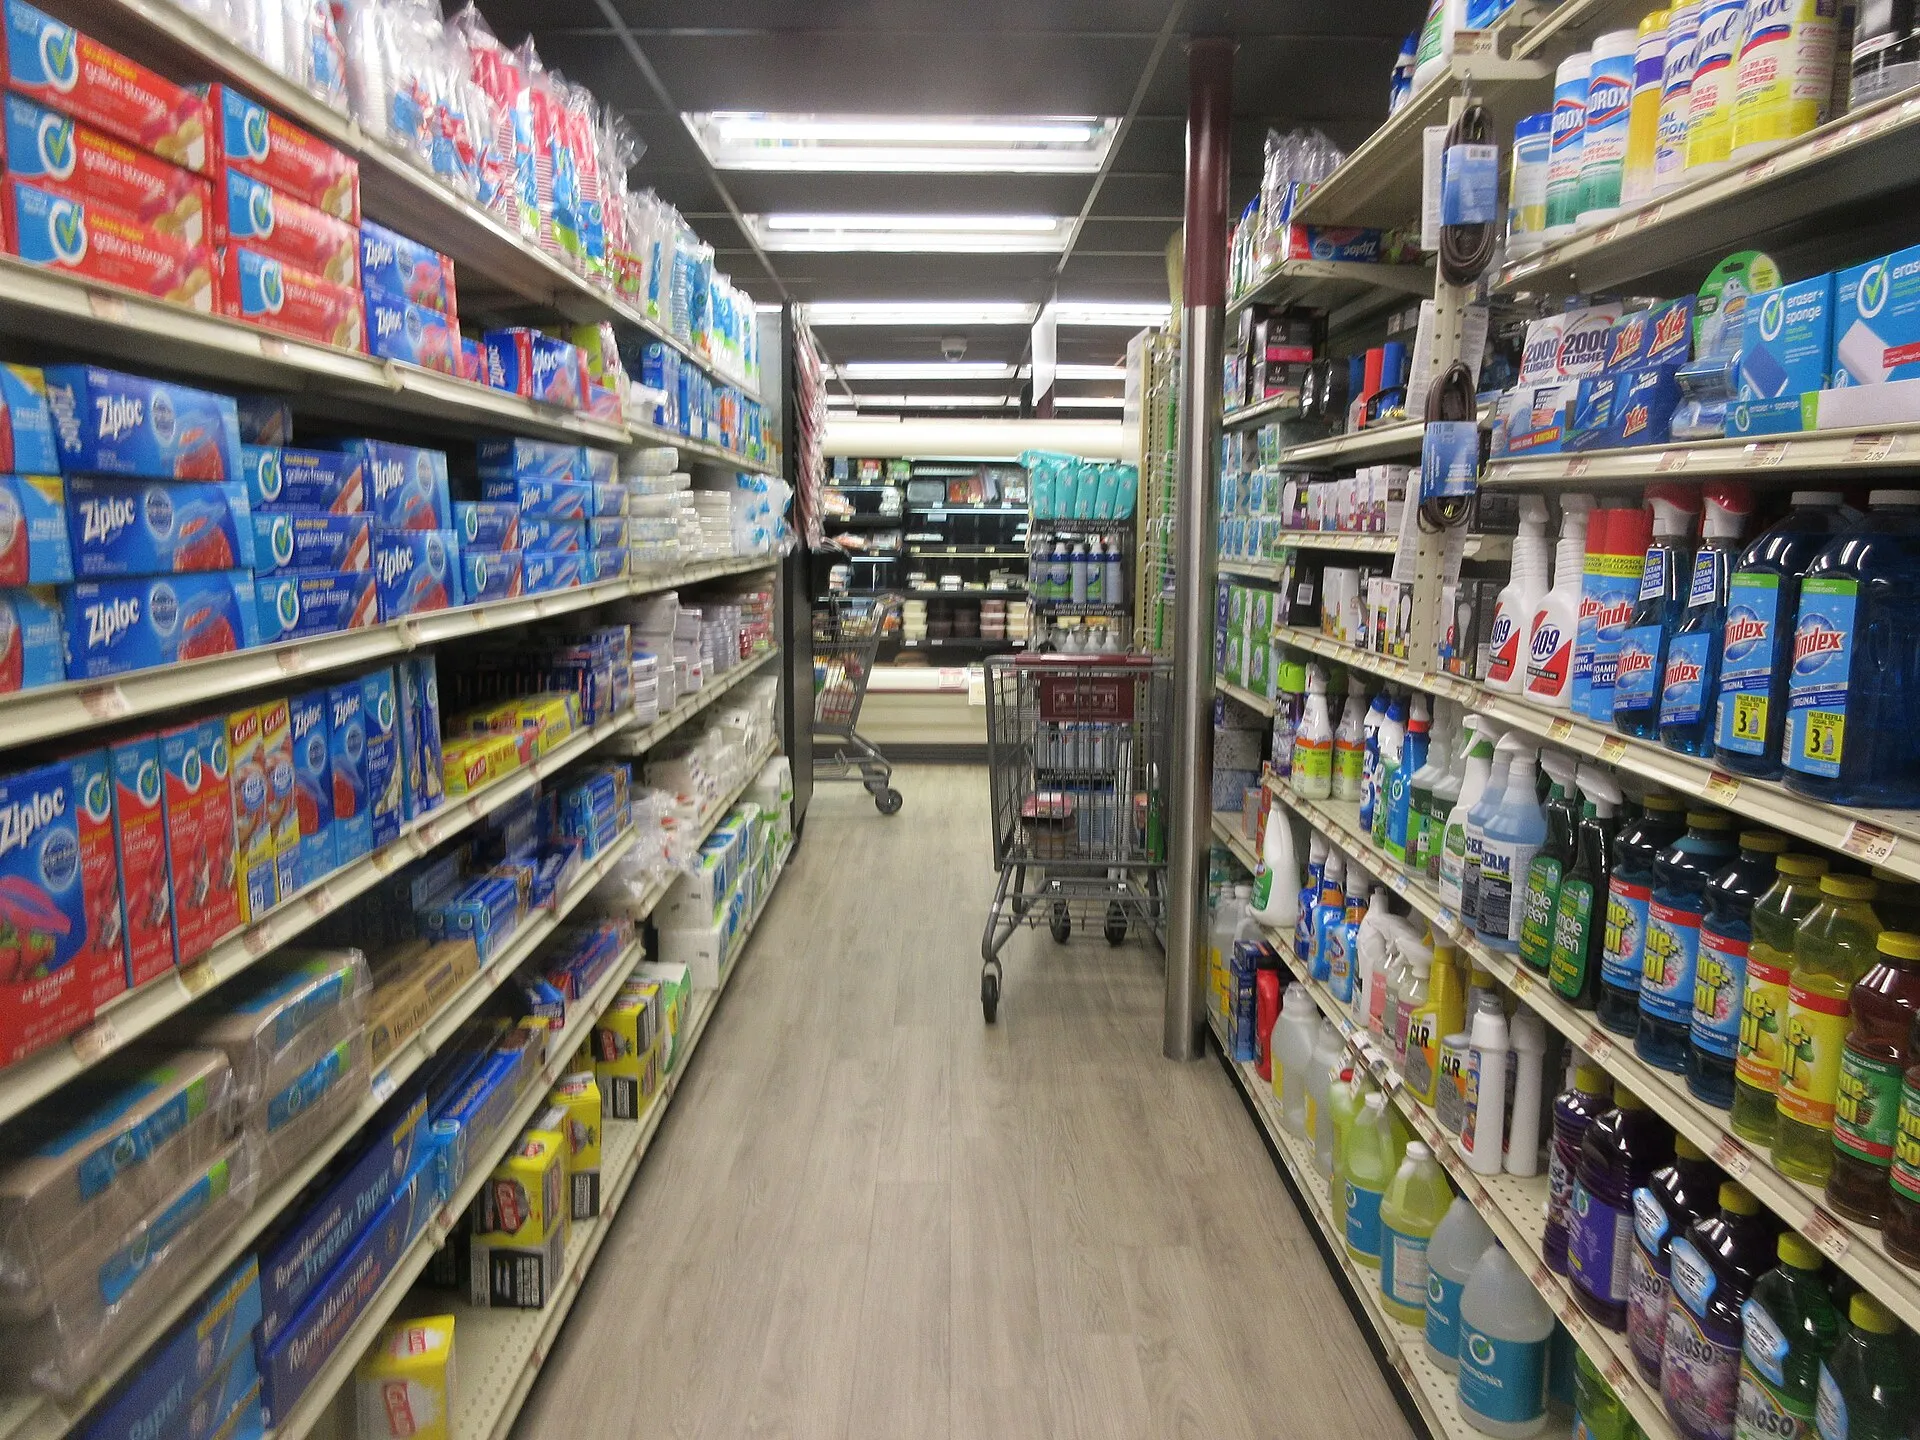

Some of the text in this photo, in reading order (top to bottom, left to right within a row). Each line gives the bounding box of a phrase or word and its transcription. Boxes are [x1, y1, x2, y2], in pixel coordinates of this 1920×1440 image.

[1691, 11, 1738, 68] ysol
[1588, 86, 1631, 113] OROX
[1553, 109, 1585, 134] OROX
[364, 238, 393, 270] Ziploc
[1344, 240, 1377, 257] Ziploc
[1786, 306, 1821, 326] sponge
[1525, 337, 1558, 364] 2000
[1564, 328, 1609, 356] 2000
[1522, 359, 1556, 376] FLUSHES
[1561, 350, 1604, 367] FLUSHE
[96, 393, 144, 440] Ziploc
[1805, 406, 1812, 418] 2
[286, 467, 310, 485] gallon
[371, 458, 405, 499] Ziploc
[79, 496, 136, 546] Ziploc
[376, 545, 414, 587] Ziploc
[85, 596, 140, 649] Ziploc
[1725, 617, 1767, 648] index
[1532, 629, 1560, 655] 409
[1794, 625, 1842, 662] index
[1573, 663, 1593, 673] LEANE
[1618, 650, 1654, 678] index
[1665, 660, 1702, 687] index
[263, 707, 286, 733] GLAD
[294, 702, 322, 740] Ziploc
[333, 693, 361, 730] Ziploc
[1738, 710, 1747, 732] 3
[234, 715, 258, 744] GLAD
[1810, 728, 1820, 753] 3
[467, 756, 487, 786] GLAD
[0, 786, 66, 854] Ziploc
[1866, 844, 1888, 858] 3.49
[1527, 887, 1552, 911] mple
[1526, 904, 1548, 927] een
[1556, 911, 1583, 937] mple
[1607, 900, 1634, 928] ne-
[1555, 928, 1579, 955] een
[1604, 926, 1622, 955] ol
[1646, 926, 1678, 957] ne-
[1644, 953, 1666, 984] ol
[1697, 956, 1730, 989] ne-
[1694, 985, 1717, 1018] ol
[1410, 1023, 1430, 1048] CLR
[1441, 1054, 1461, 1078] CLR
[356, 1171, 390, 1220] Paper
